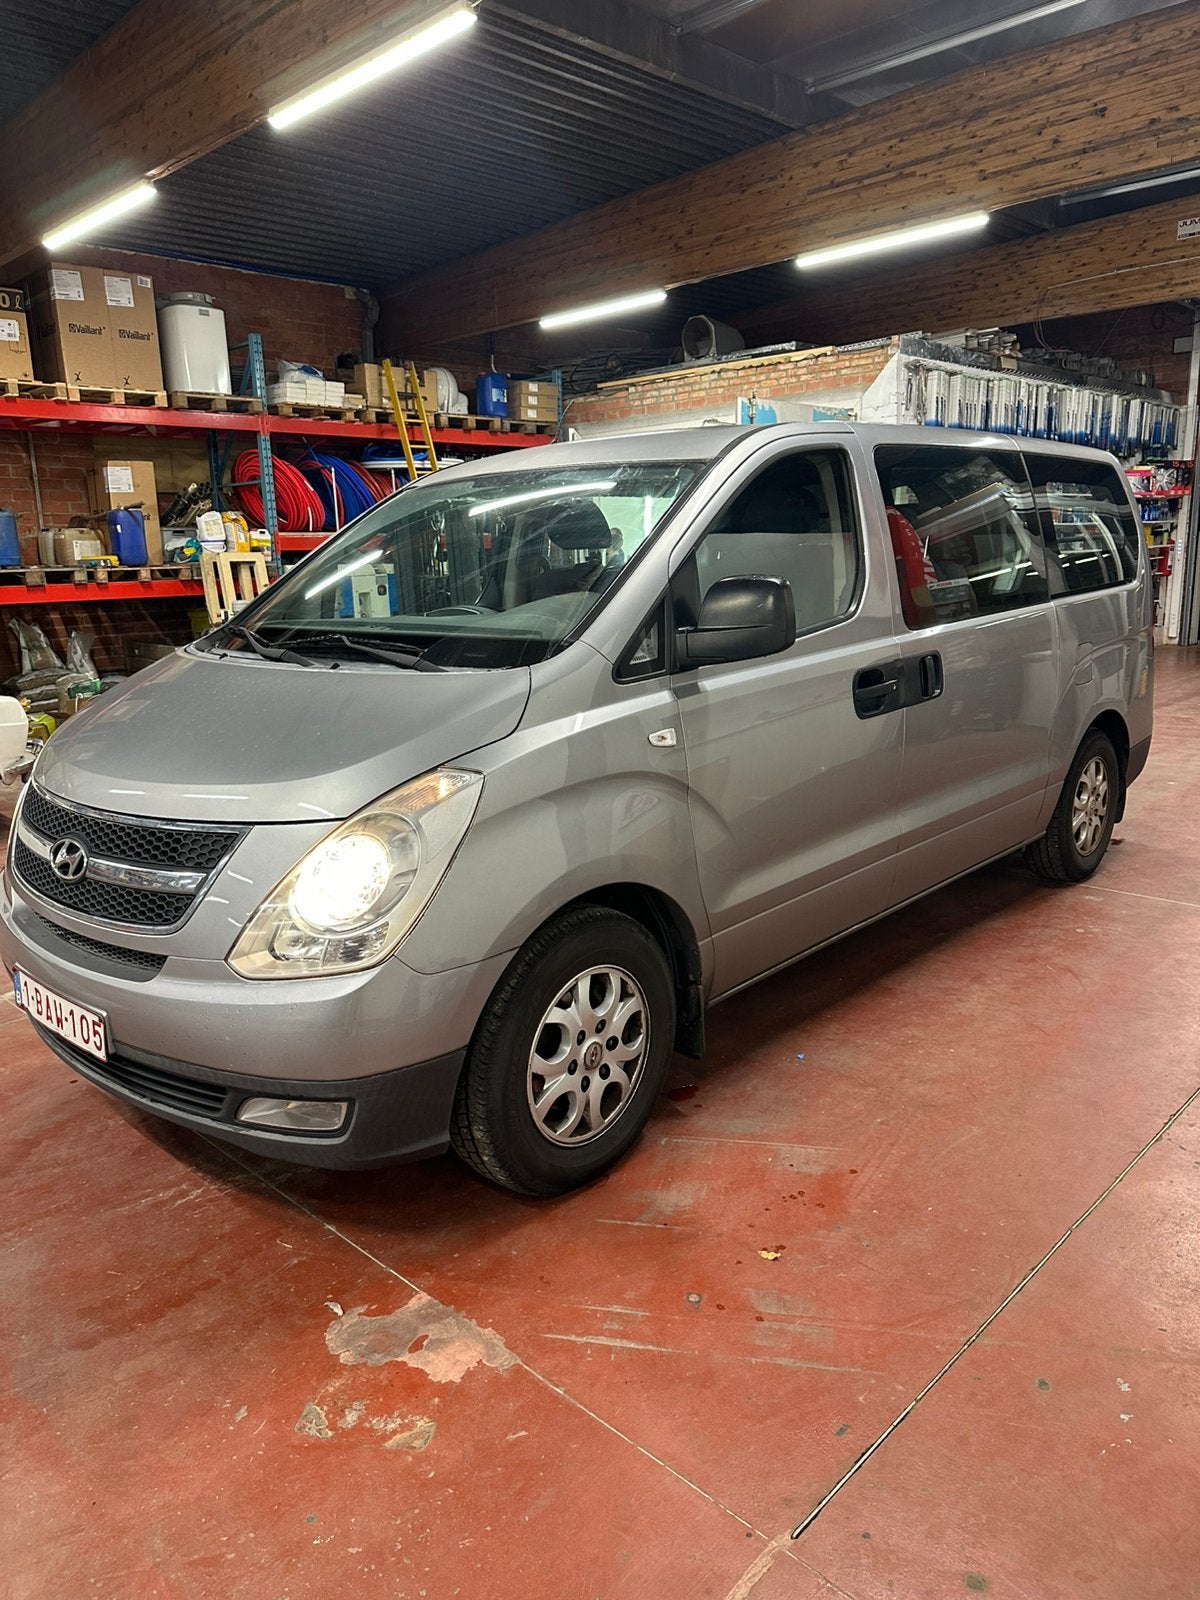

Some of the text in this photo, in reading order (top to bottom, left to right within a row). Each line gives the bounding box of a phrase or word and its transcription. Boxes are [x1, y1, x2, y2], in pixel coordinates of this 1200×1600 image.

[74, 324, 103, 335] Vaillant
[124, 330, 151, 341] Vaillant
[23, 980, 103, 1051] 1-BAW-105
